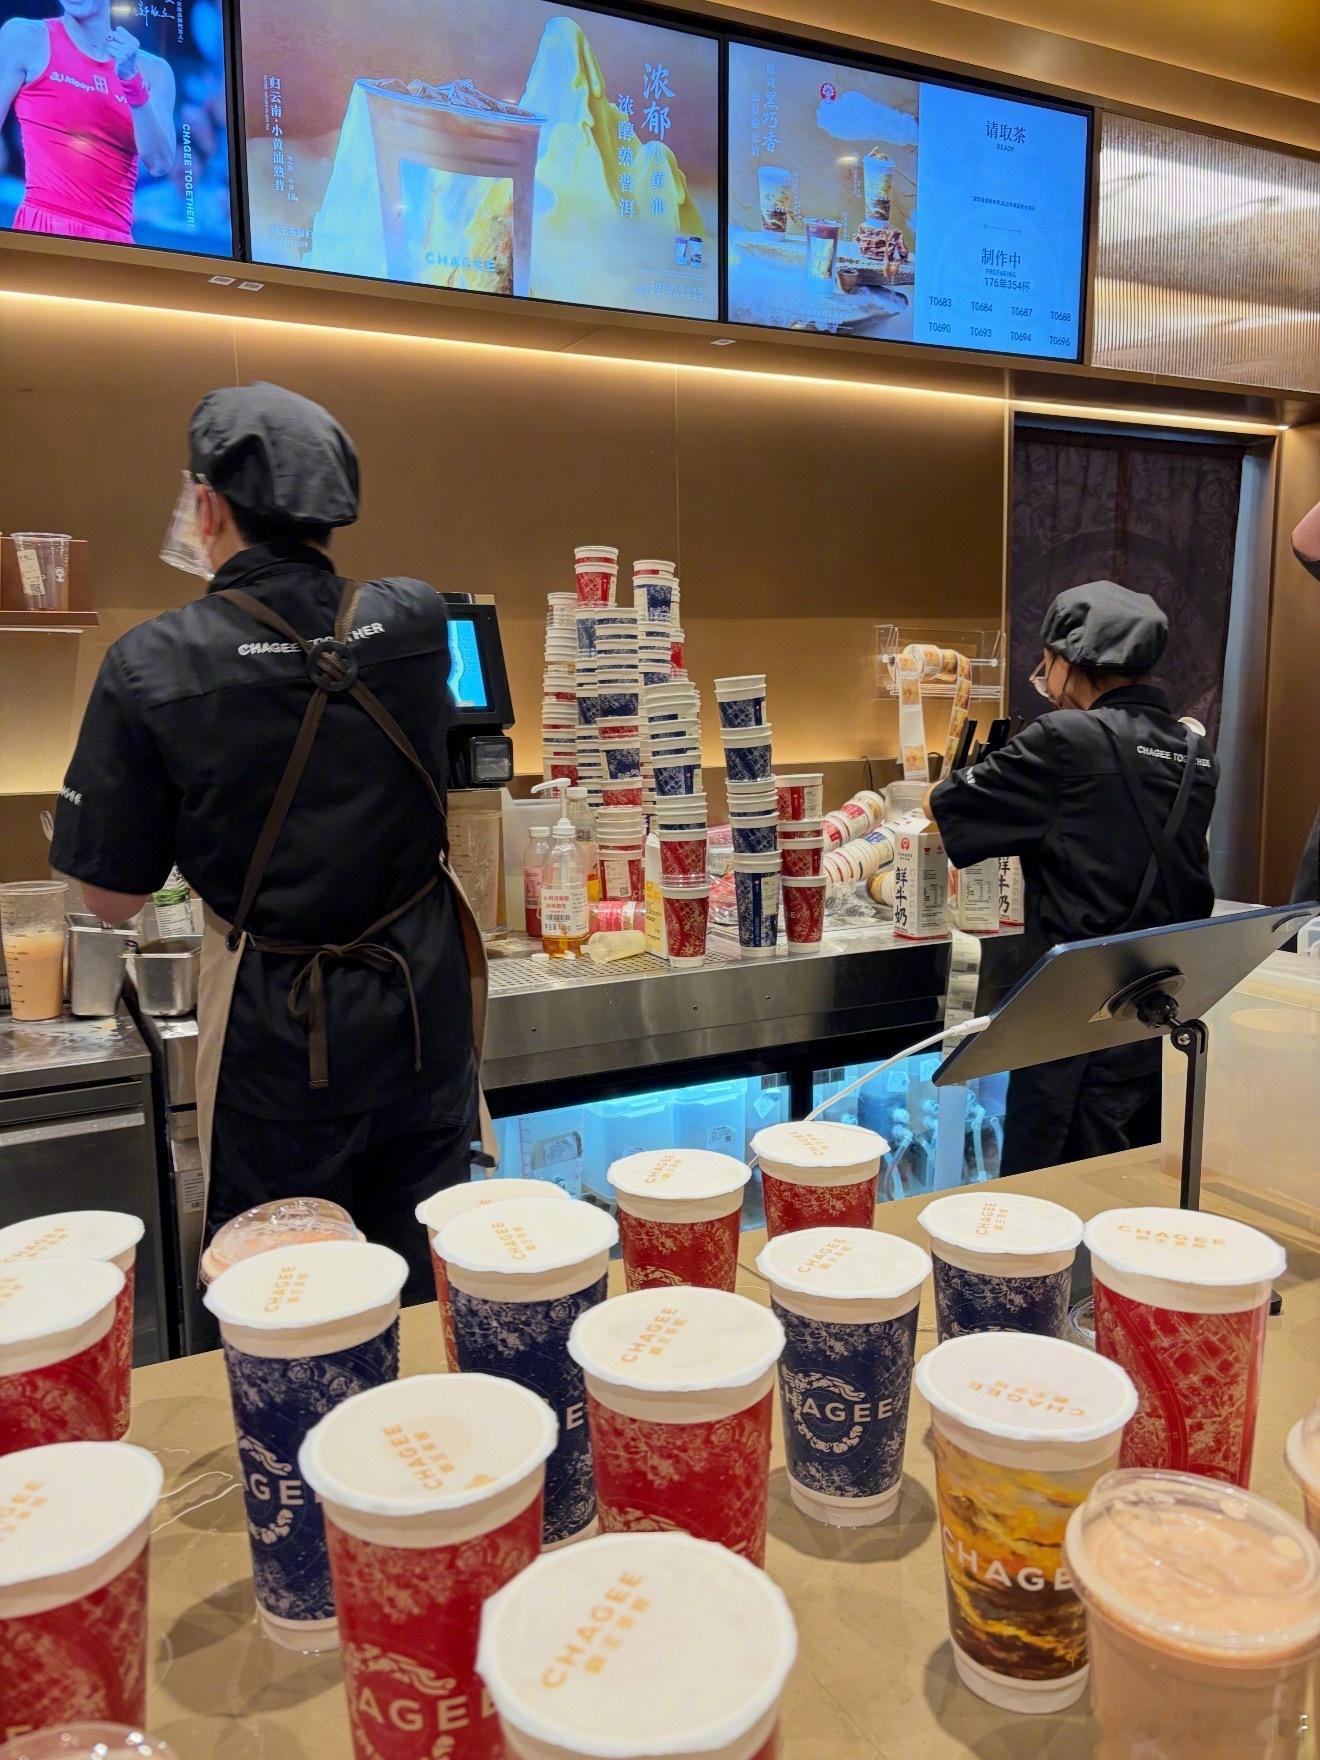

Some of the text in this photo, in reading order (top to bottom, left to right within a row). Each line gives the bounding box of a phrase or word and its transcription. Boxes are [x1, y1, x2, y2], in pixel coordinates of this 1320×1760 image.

[641, 63, 676, 141] 浓郁
[183, 124, 192, 166] CHAGEE
[986, 121, 1026, 144] 请取茶
[996, 143, 1015, 152] READY
[425, 252, 496, 272] CHAGEE
[981, 248, 1021, 269] 制作中
[985, 268, 1017, 278] PREPARING
[984, 277, 1031, 292] 176单354杯
[929, 296, 1072, 322] T0683 T0684 T0687 T0688
[928, 321, 1071, 347] T0690 T0693 T0694 T0696
[237, 642, 302, 656] CHAGEE
[1136, 745, 1173, 760] CHAGEE
[895, 866, 908, 927] 鲜牛奶
[975, 1201, 997, 1235] CHAGEE
[491, 1222, 527, 1260] CHAGEE
[1118, 1225, 1227, 1245] CHAGEE
[798, 1238, 847, 1272] CHAGEE
[264, 1265, 296, 1312] CHAGEE
[621, 1307, 679, 1362] CHAGEE
[967, 1381, 1085, 1416] CHAGEE
[383, 1425, 443, 1490] CHAGEE
[540, 1572, 643, 1689] CHAGEE
